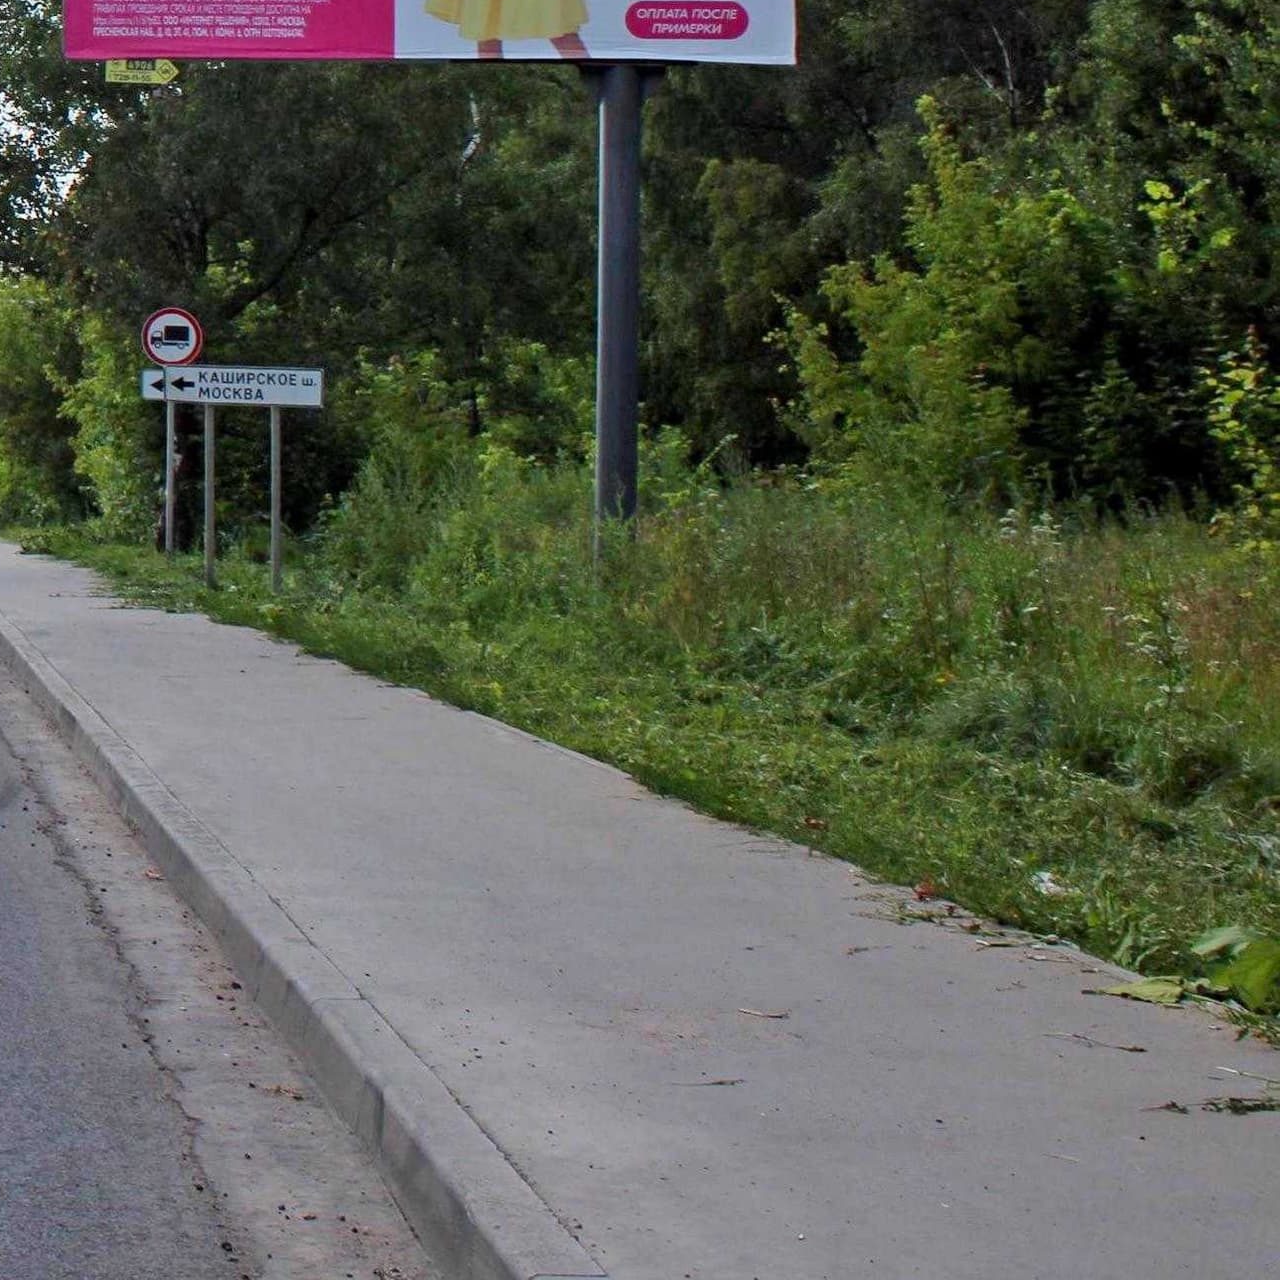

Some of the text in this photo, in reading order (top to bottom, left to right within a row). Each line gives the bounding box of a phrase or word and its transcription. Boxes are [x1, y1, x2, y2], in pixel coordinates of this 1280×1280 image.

[637, 8, 738, 19] ОПЛАТА ПОСЛЕ
[652, 23, 722, 34] ПРИМЕРКИ
[198, 371, 297, 386] КАШИРСКОЕ
[198, 387, 264, 401] МОСКВА
